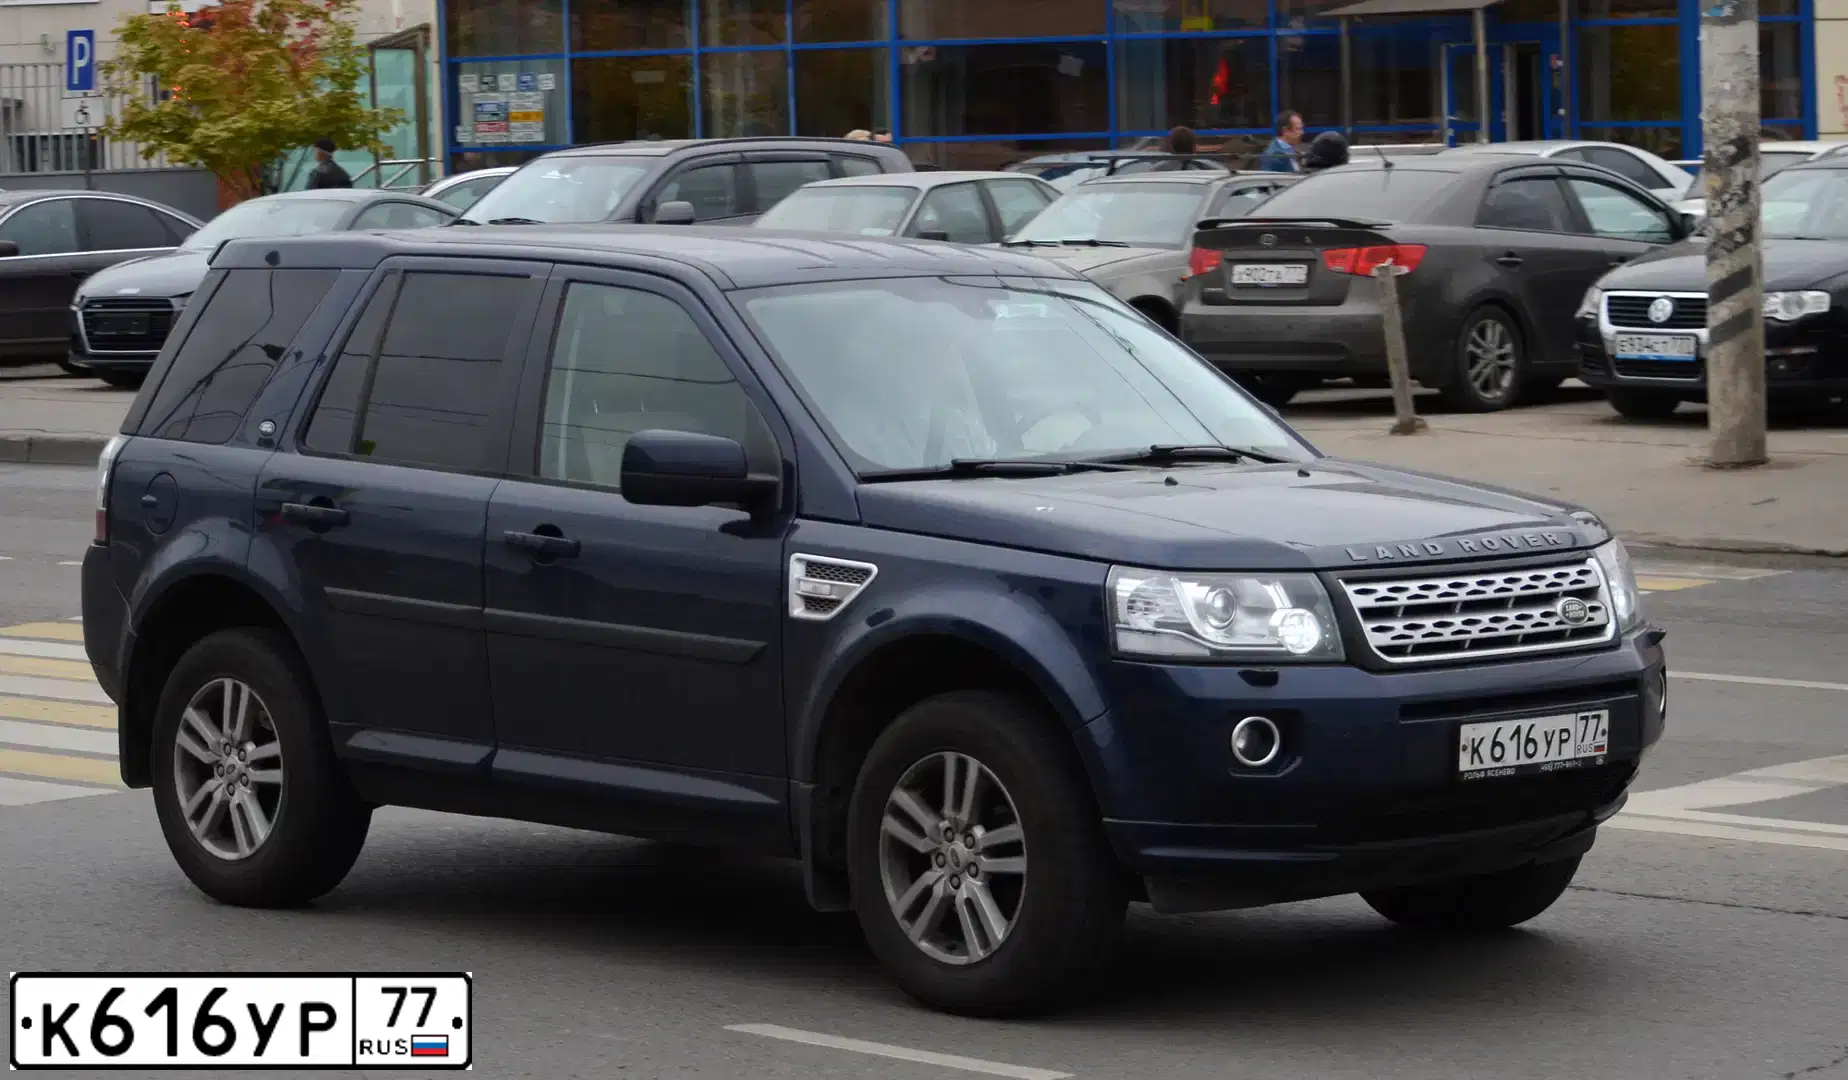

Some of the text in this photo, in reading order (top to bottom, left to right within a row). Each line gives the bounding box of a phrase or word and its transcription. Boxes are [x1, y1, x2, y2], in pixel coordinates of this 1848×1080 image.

[73, 36, 91, 85] P
[1344, 531, 1563, 562] LAND ROVER
[1580, 713, 1602, 743] 77
[1470, 724, 1571, 765] К616УР
[1576, 744, 1594, 754] RUS
